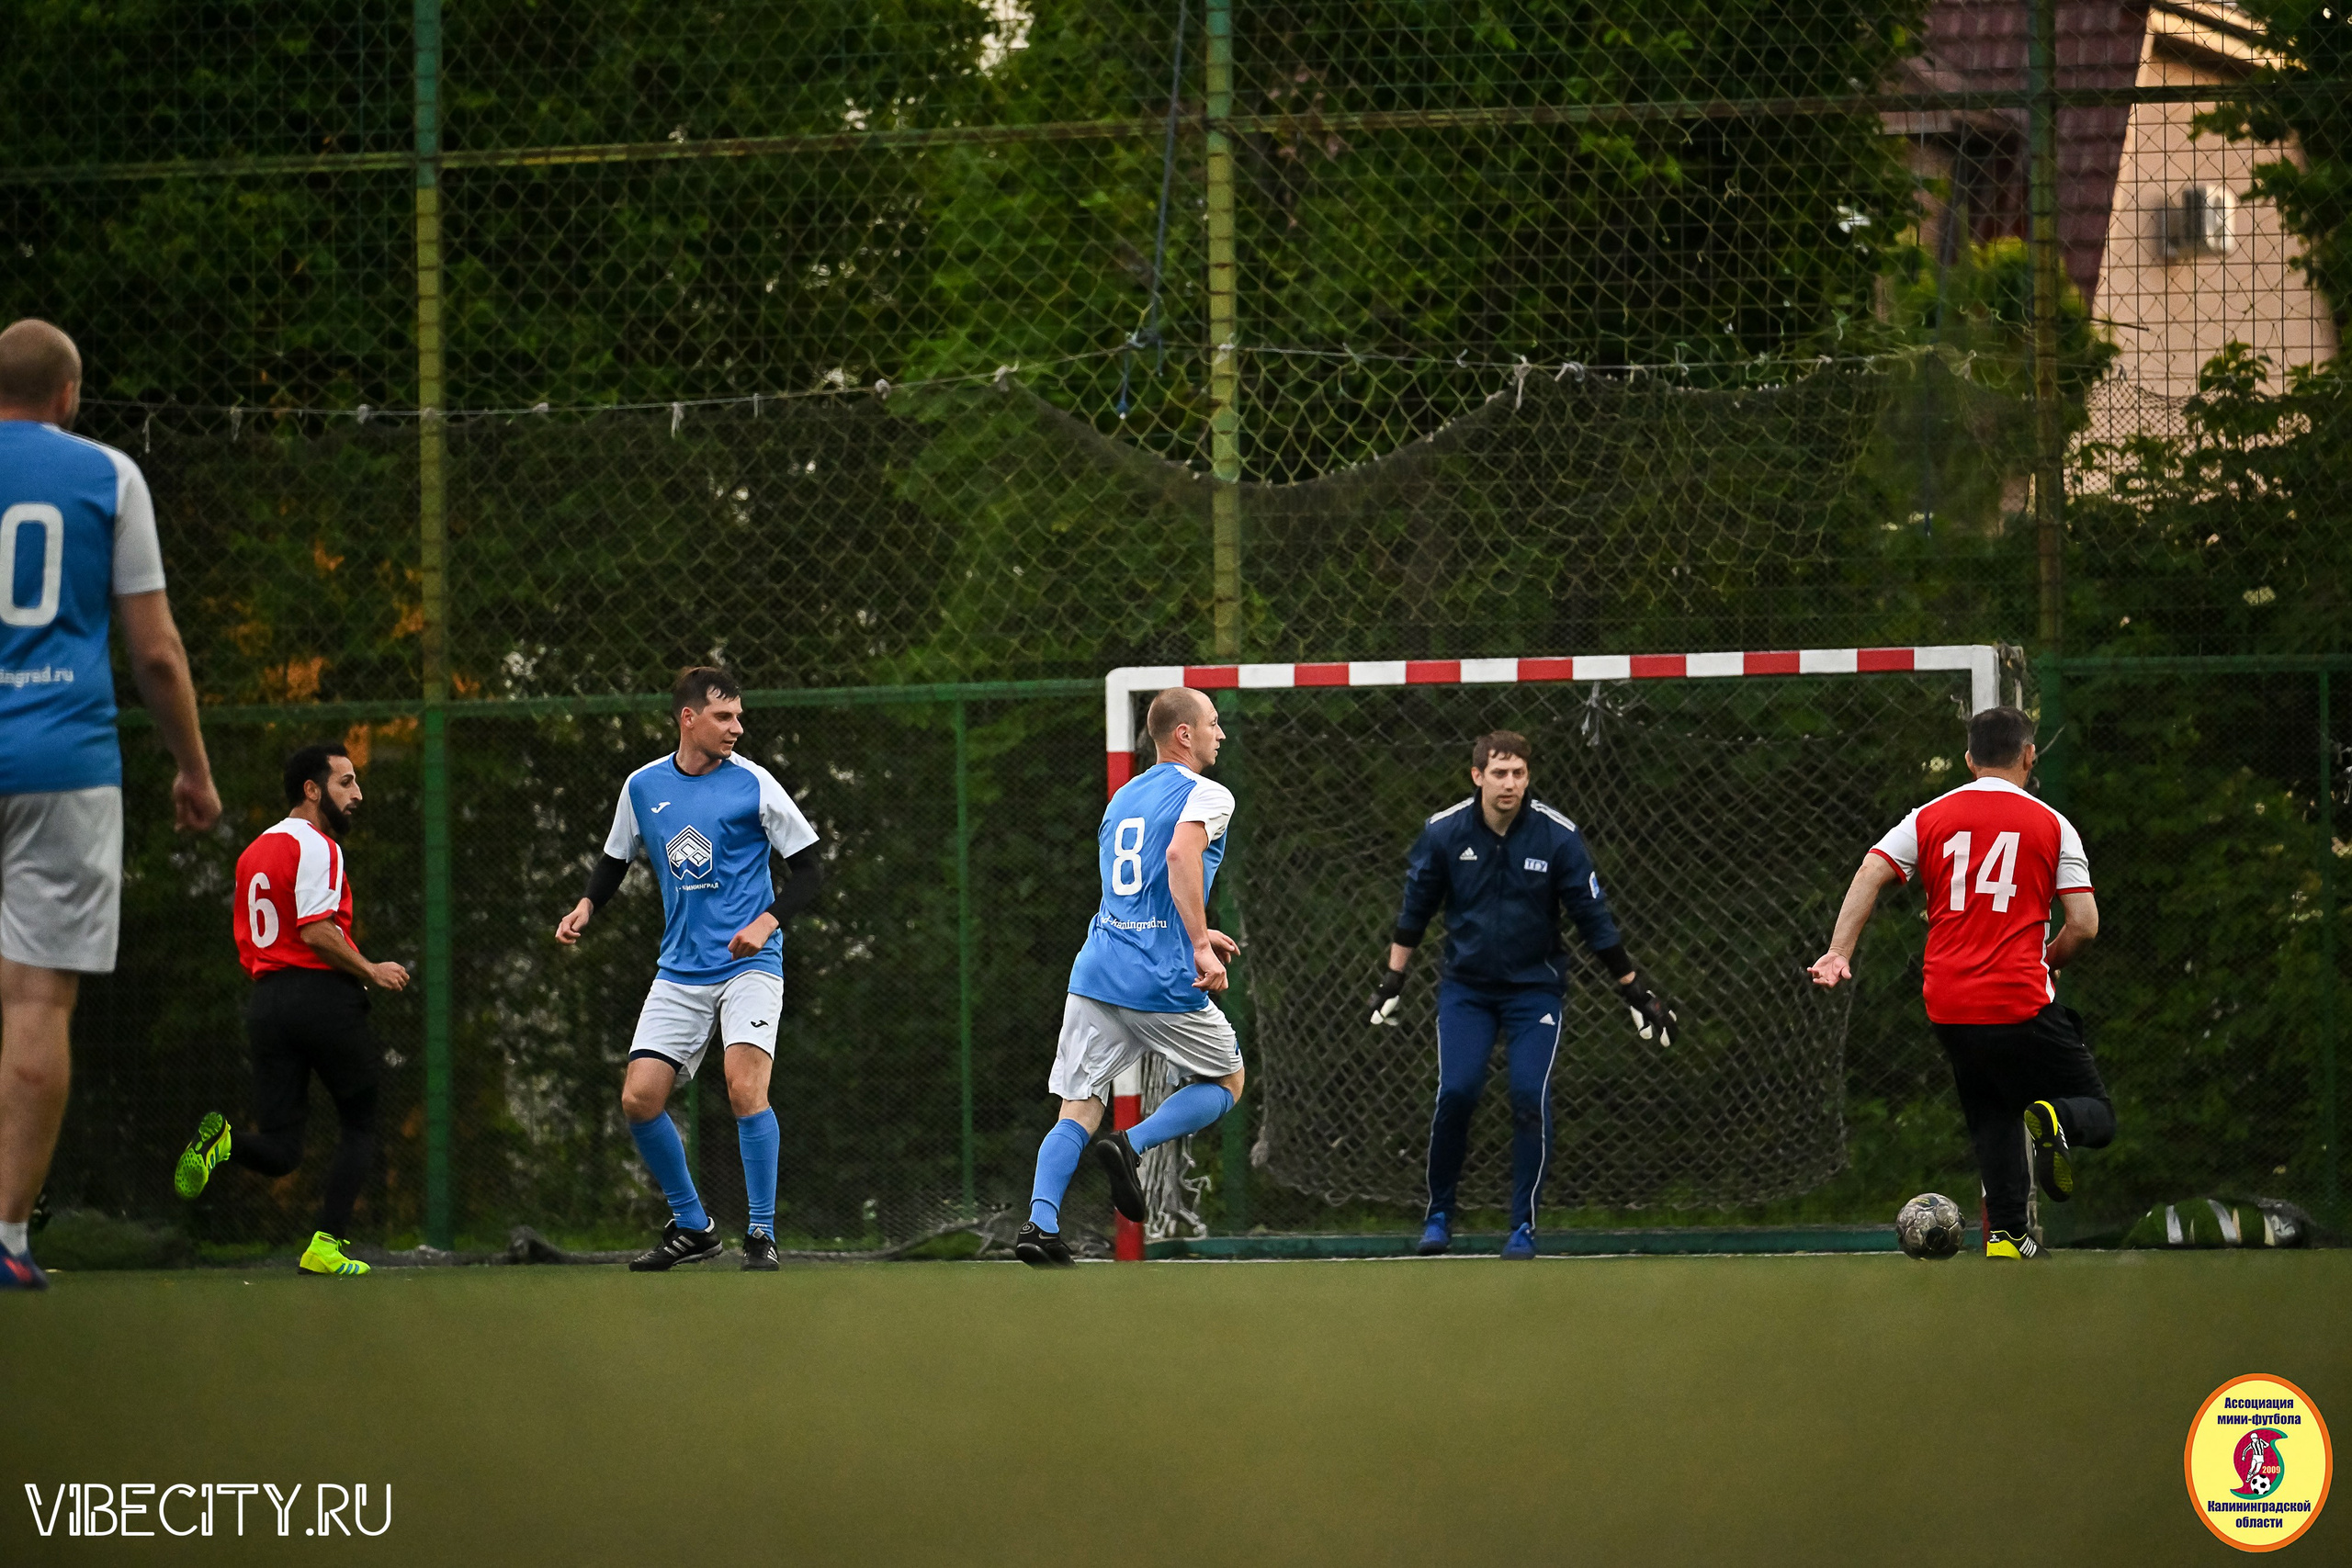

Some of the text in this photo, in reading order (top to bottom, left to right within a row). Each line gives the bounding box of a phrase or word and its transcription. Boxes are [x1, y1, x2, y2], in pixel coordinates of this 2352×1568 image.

[1112, 817, 1146, 896] 8
[1942, 830, 2020, 913] 14
[247, 872, 279, 949] 6
